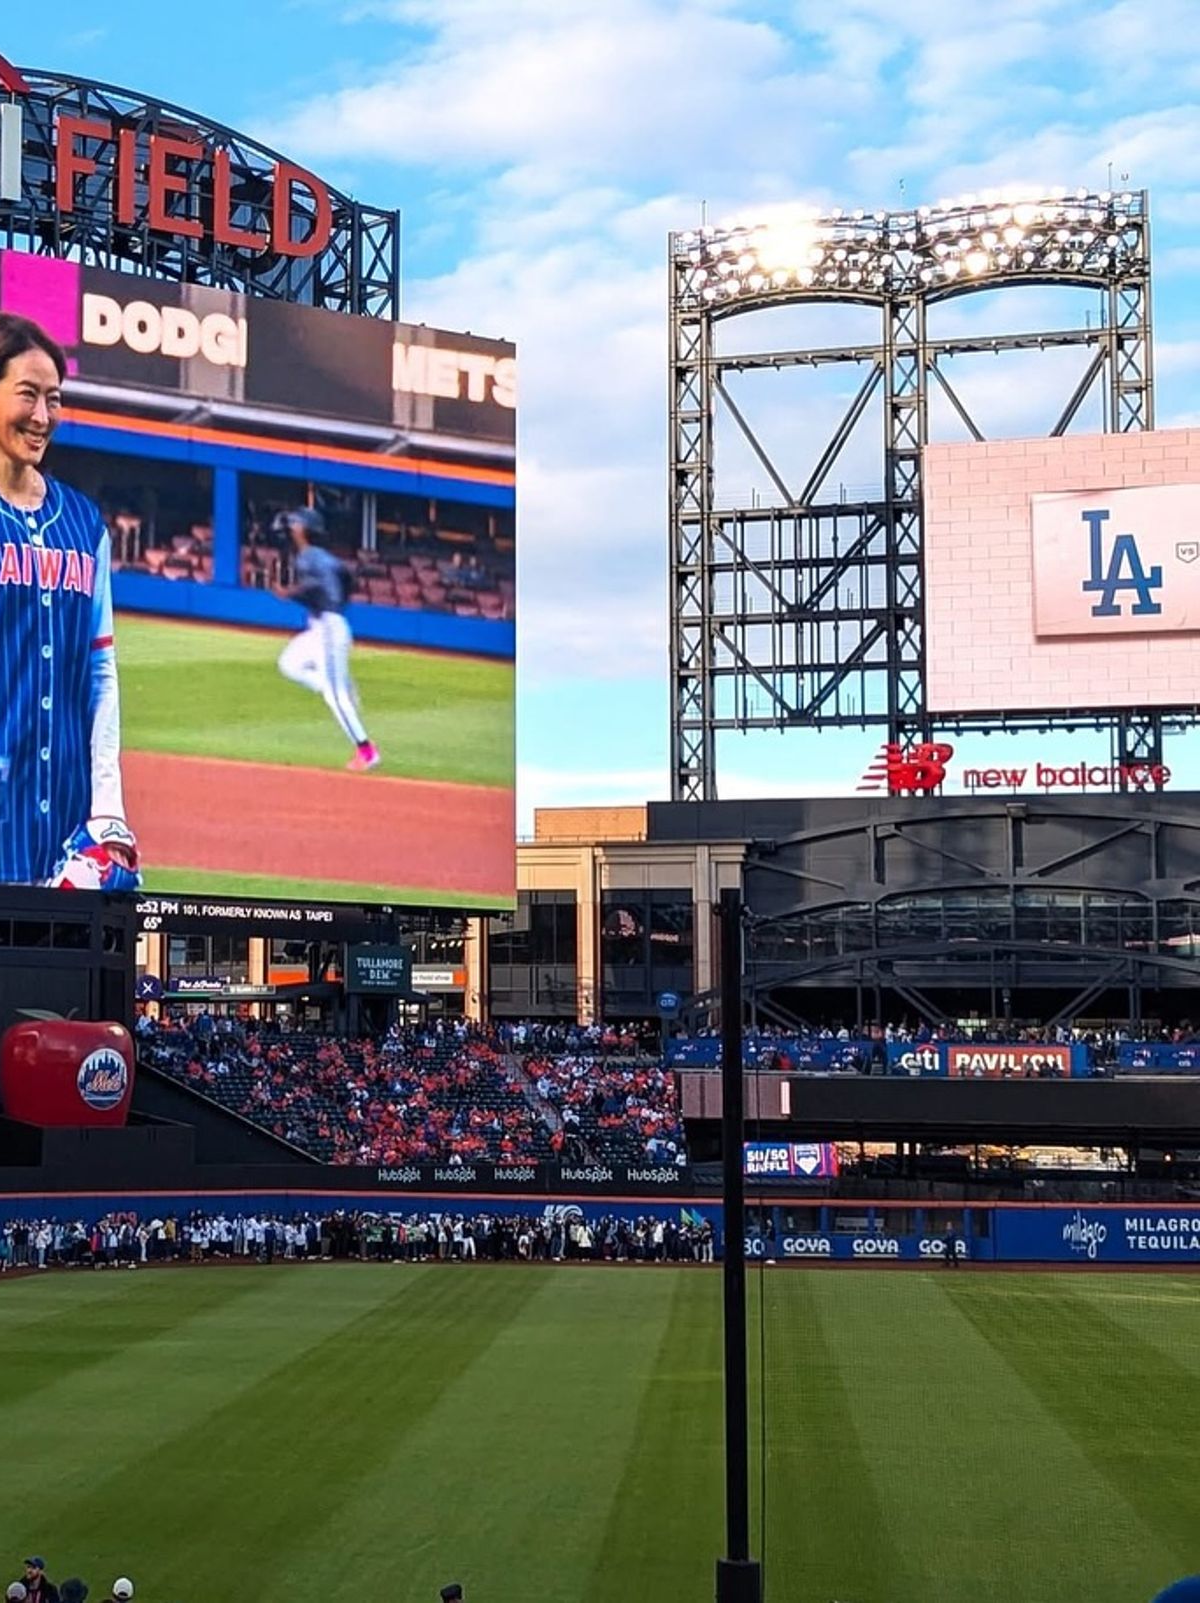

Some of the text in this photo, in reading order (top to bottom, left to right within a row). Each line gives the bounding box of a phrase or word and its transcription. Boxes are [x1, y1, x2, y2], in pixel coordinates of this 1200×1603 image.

[55, 113, 332, 258] FIELD
[392, 343, 517, 408] METS
[1082, 510, 1162, 617] LA
[963, 767, 1027, 789] new
[1037, 762, 1172, 788] balance
[161, 901, 178, 915] PM
[202, 905, 252, 919] FORMERLY
[253, 908, 288, 920] KNOWN
[289, 909, 301, 920] AS
[305, 910, 333, 922] TAIPEI
[356, 957, 403, 969] TULLAMORE
[901, 1049, 940, 1071] citi
[746, 1149, 789, 1162] 50/50
[378, 1165, 679, 1183] HubSpot HubSpot HubSpot HubSpot HubSpot
[746, 1160, 790, 1174] RAFFLE
[1125, 1218, 1200, 1232] MILAGRO
[783, 1238, 966, 1254] GOYA GOYA GOA
[1127, 1236, 1200, 1250] TEQUILA
